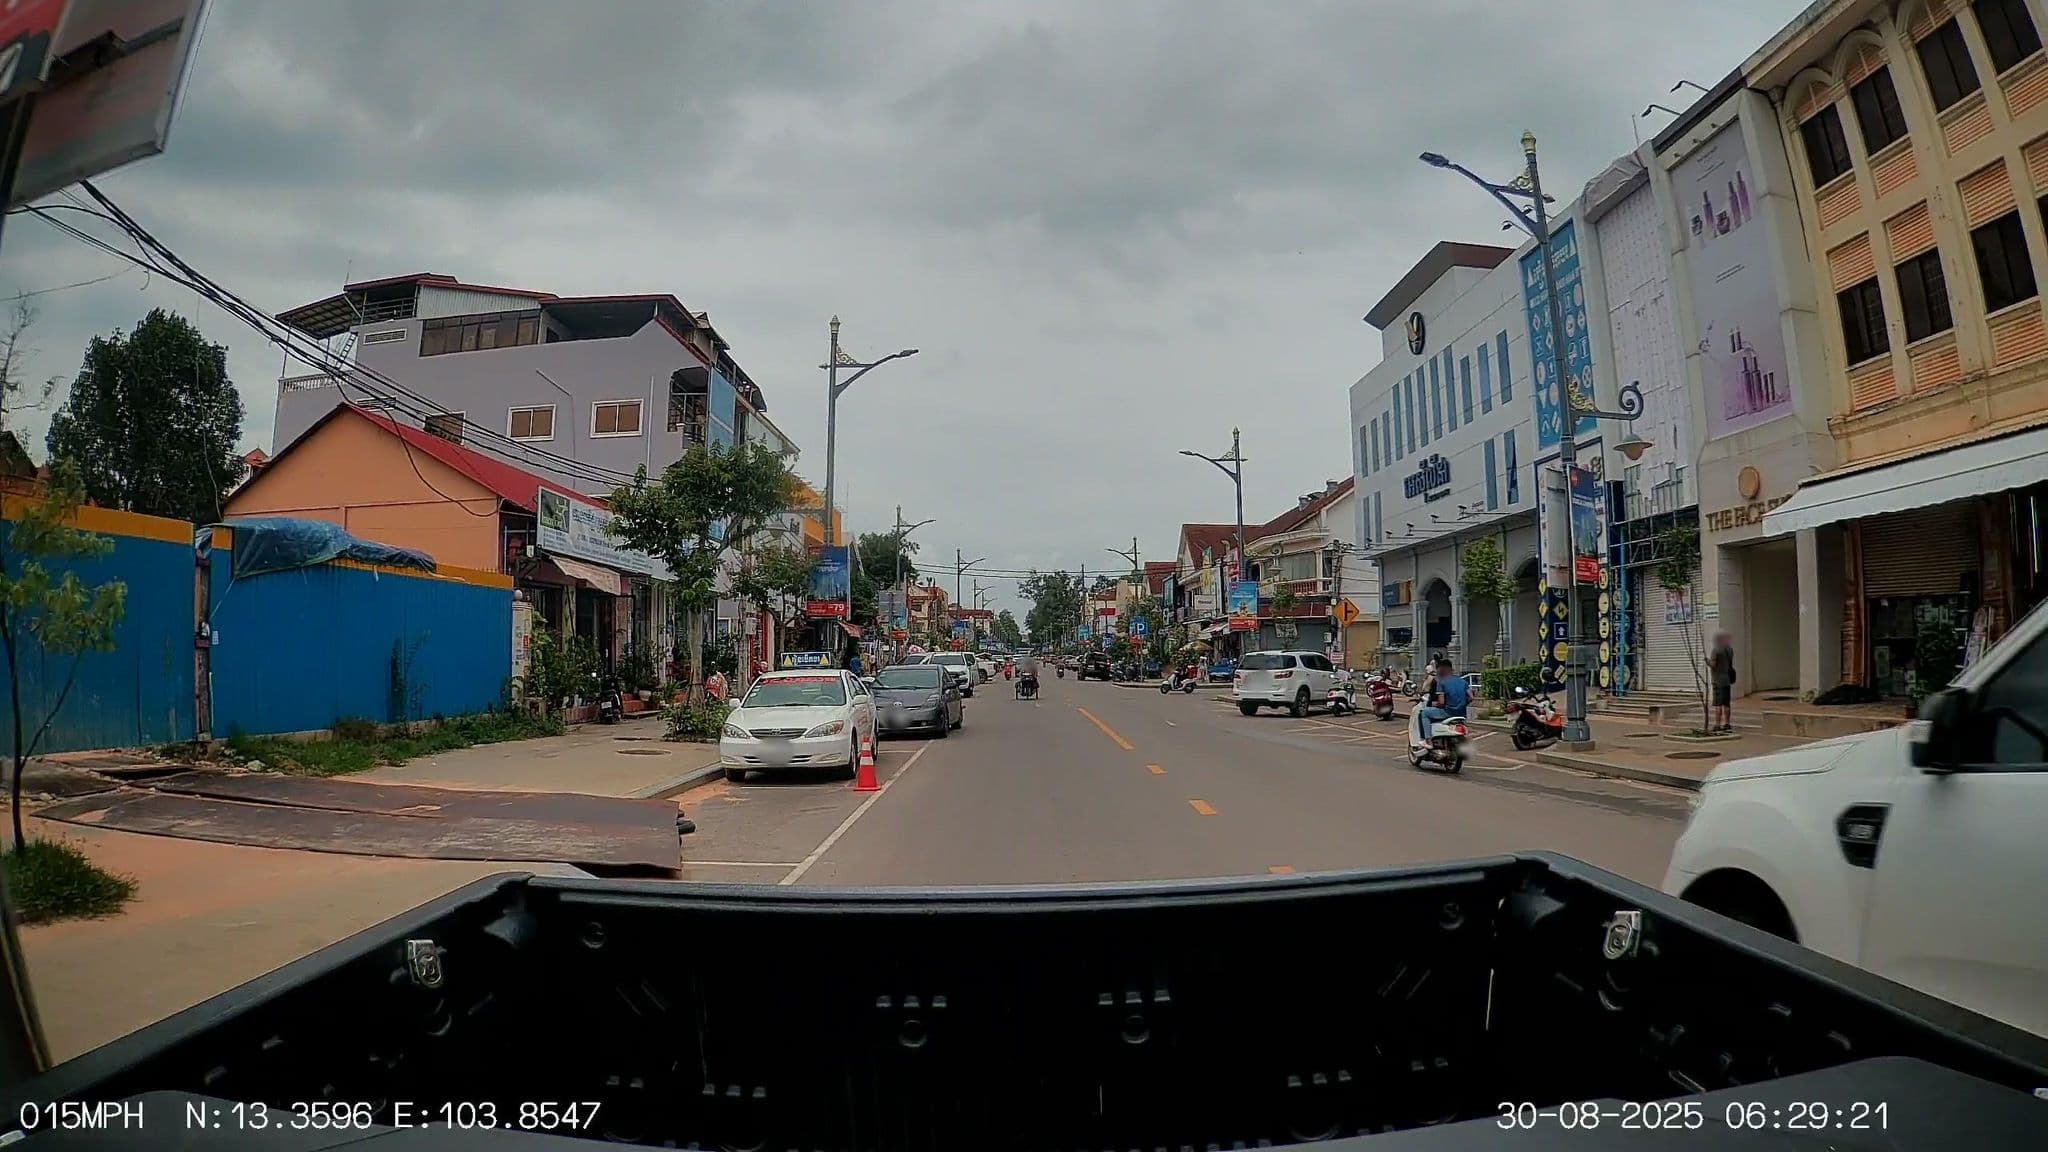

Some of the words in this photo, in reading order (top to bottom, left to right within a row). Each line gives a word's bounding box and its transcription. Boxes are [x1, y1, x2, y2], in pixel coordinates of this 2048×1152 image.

[1705, 509, 1733, 533] THE
[834, 603, 845, 611] 79
[1137, 623, 1145, 634] P
